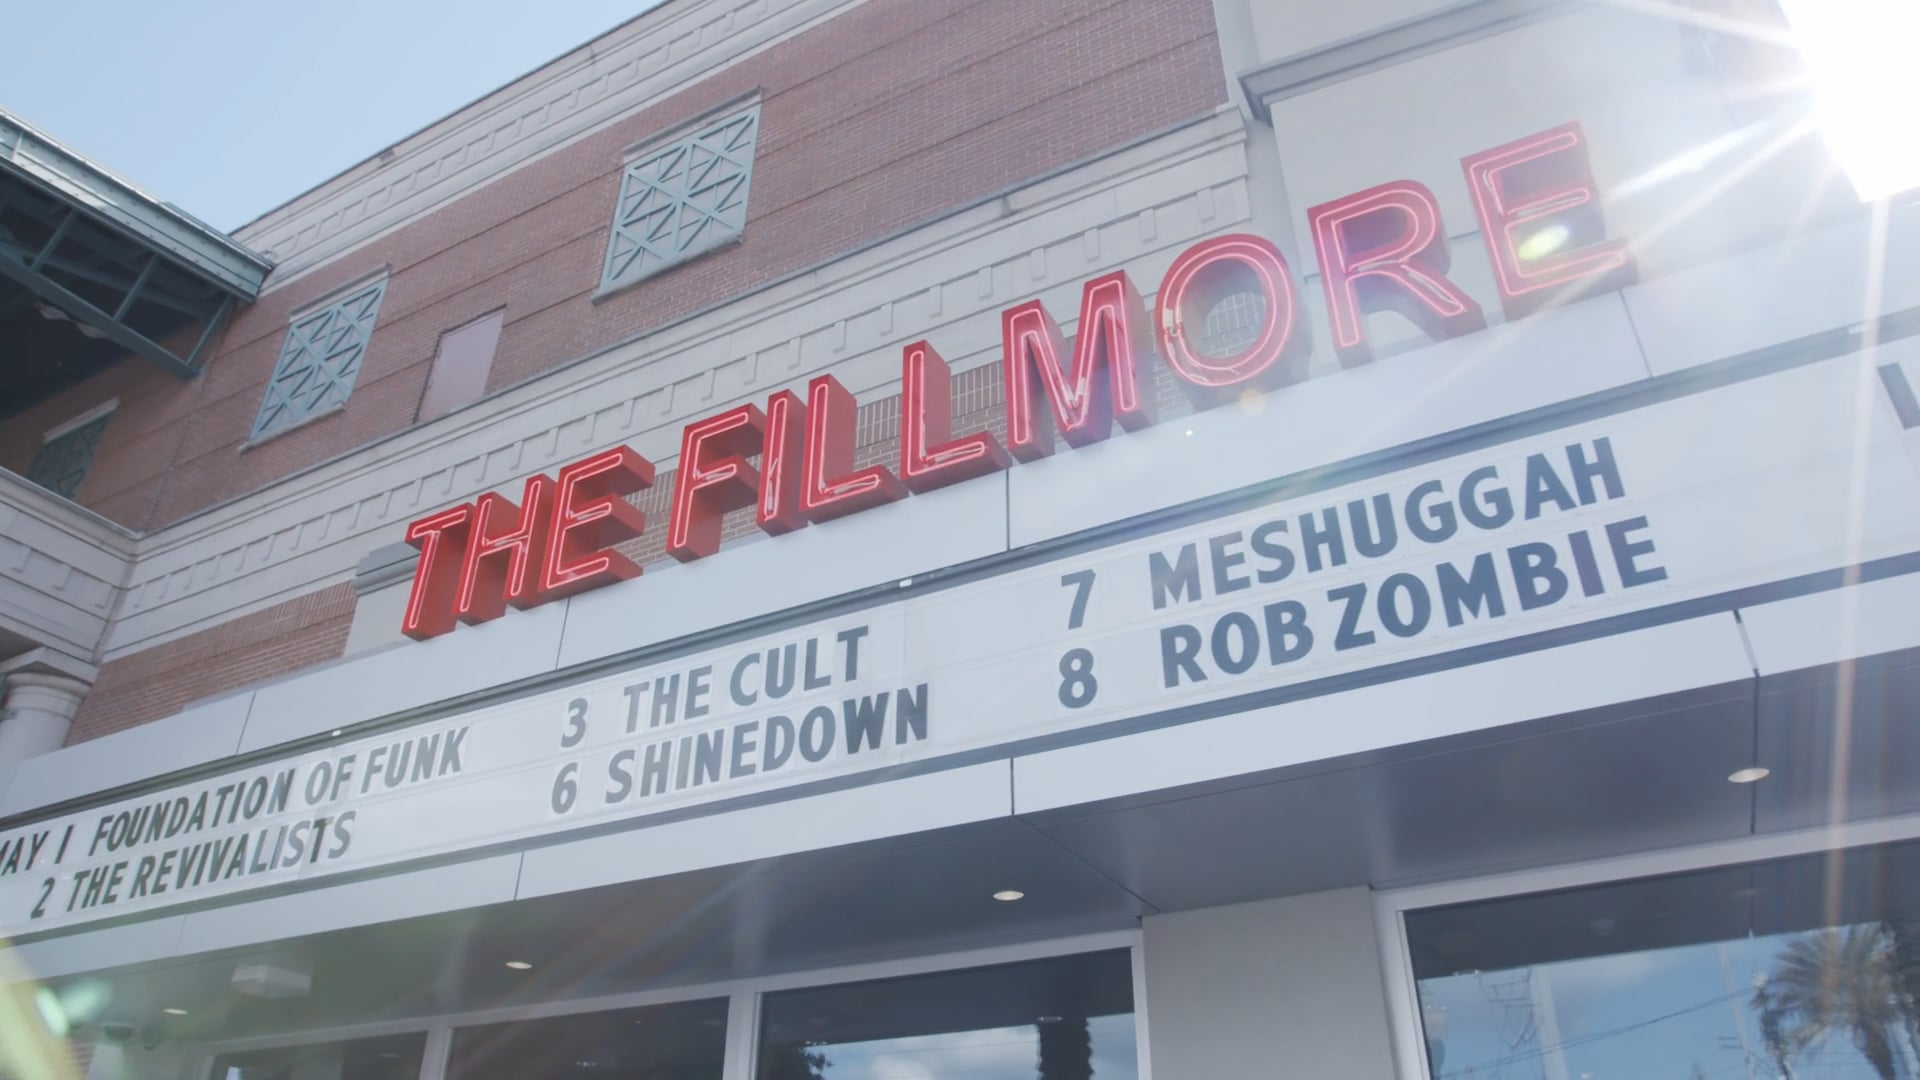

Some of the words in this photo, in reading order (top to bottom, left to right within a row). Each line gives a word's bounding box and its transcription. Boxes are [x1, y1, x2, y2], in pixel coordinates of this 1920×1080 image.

[402, 445, 656, 641] THE
[666, 121, 1638, 563] FILLMORE
[1061, 569, 1096, 629] 7
[1148, 436, 1626, 609] MESHUGGAH
[1058, 648, 1098, 708] 8
[1160, 600, 1314, 688] ROB
[1326, 515, 1668, 651] ZOMBIE
[551, 762, 577, 814] 6
[605, 683, 928, 803] SHINEDOWN
[560, 698, 588, 747] 3
[622, 666, 713, 734] THE
[729, 625, 869, 706] CULT
[88, 769, 295, 857] FOUNDATION
[305, 754, 357, 805] OF
[361, 727, 469, 794] FUNK
[31, 878, 55, 918] 2
[67, 862, 124, 912] THE
[130, 811, 357, 896] REVIVALISTS
